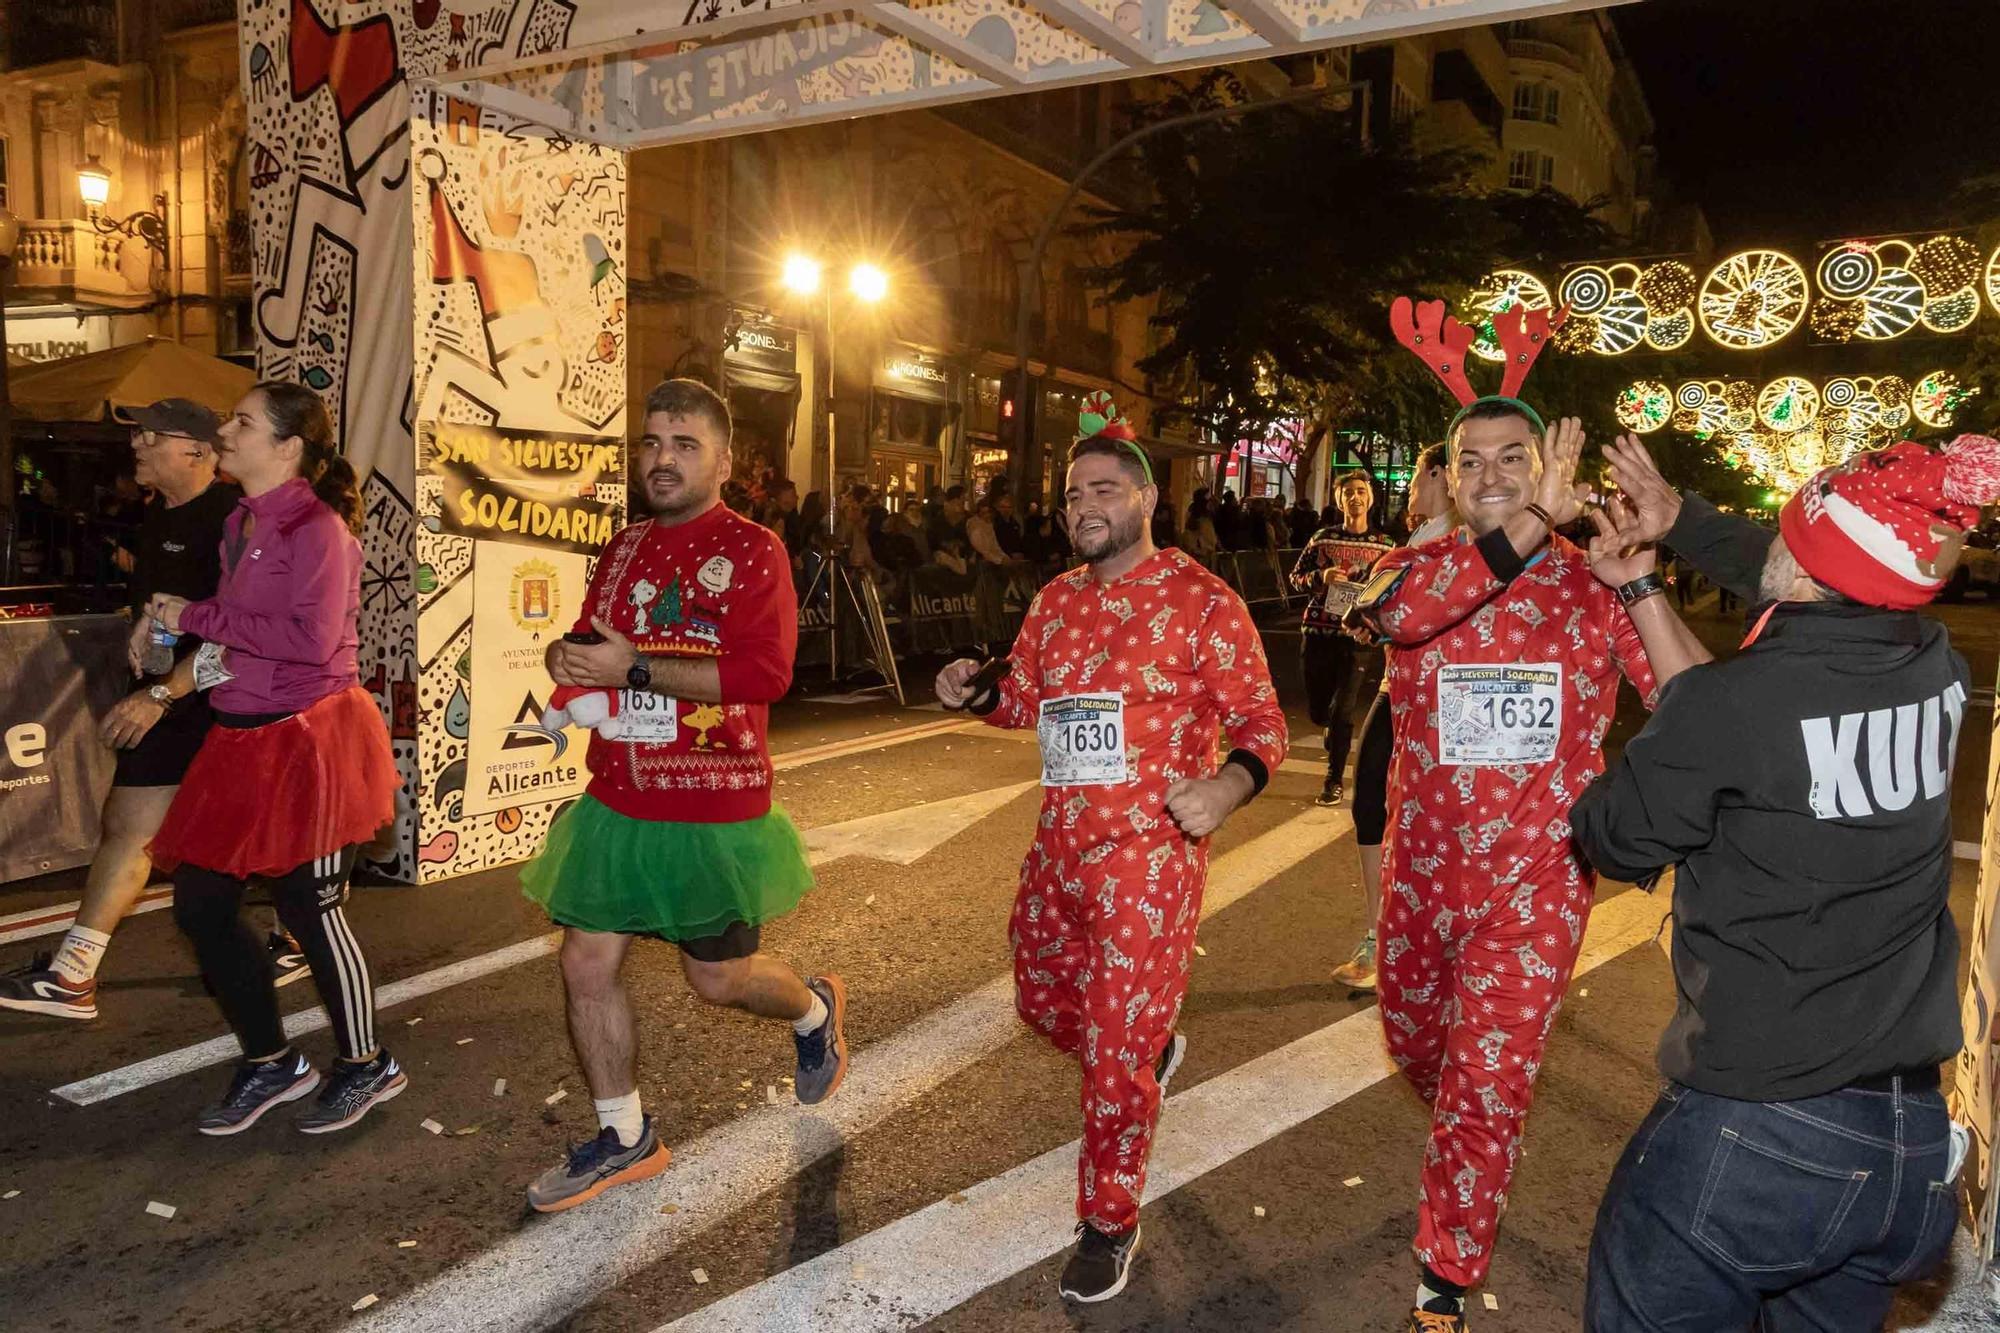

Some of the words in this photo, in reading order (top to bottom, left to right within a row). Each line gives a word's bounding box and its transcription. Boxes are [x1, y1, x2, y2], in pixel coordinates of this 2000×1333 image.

[48, 340, 88, 358] ROOM
[569, 373, 609, 410] RUN
[434, 431, 490, 464] SAN
[500, 437, 621, 473] SILVESTRE
[460, 488, 613, 547] SOLIDARIA
[508, 662, 521, 670] DE
[1507, 670, 1555, 683] SOLIDARIA
[621, 688, 668, 711] 1631
[1079, 698, 1118, 711] SOLIDARIA
[1483, 696, 1555, 729] 1632
[1062, 722, 1118, 753] 1630
[486, 760, 536, 773] DEPORTES
[487, 765, 577, 795] Alicante
[318, 894, 340, 907] adidas
